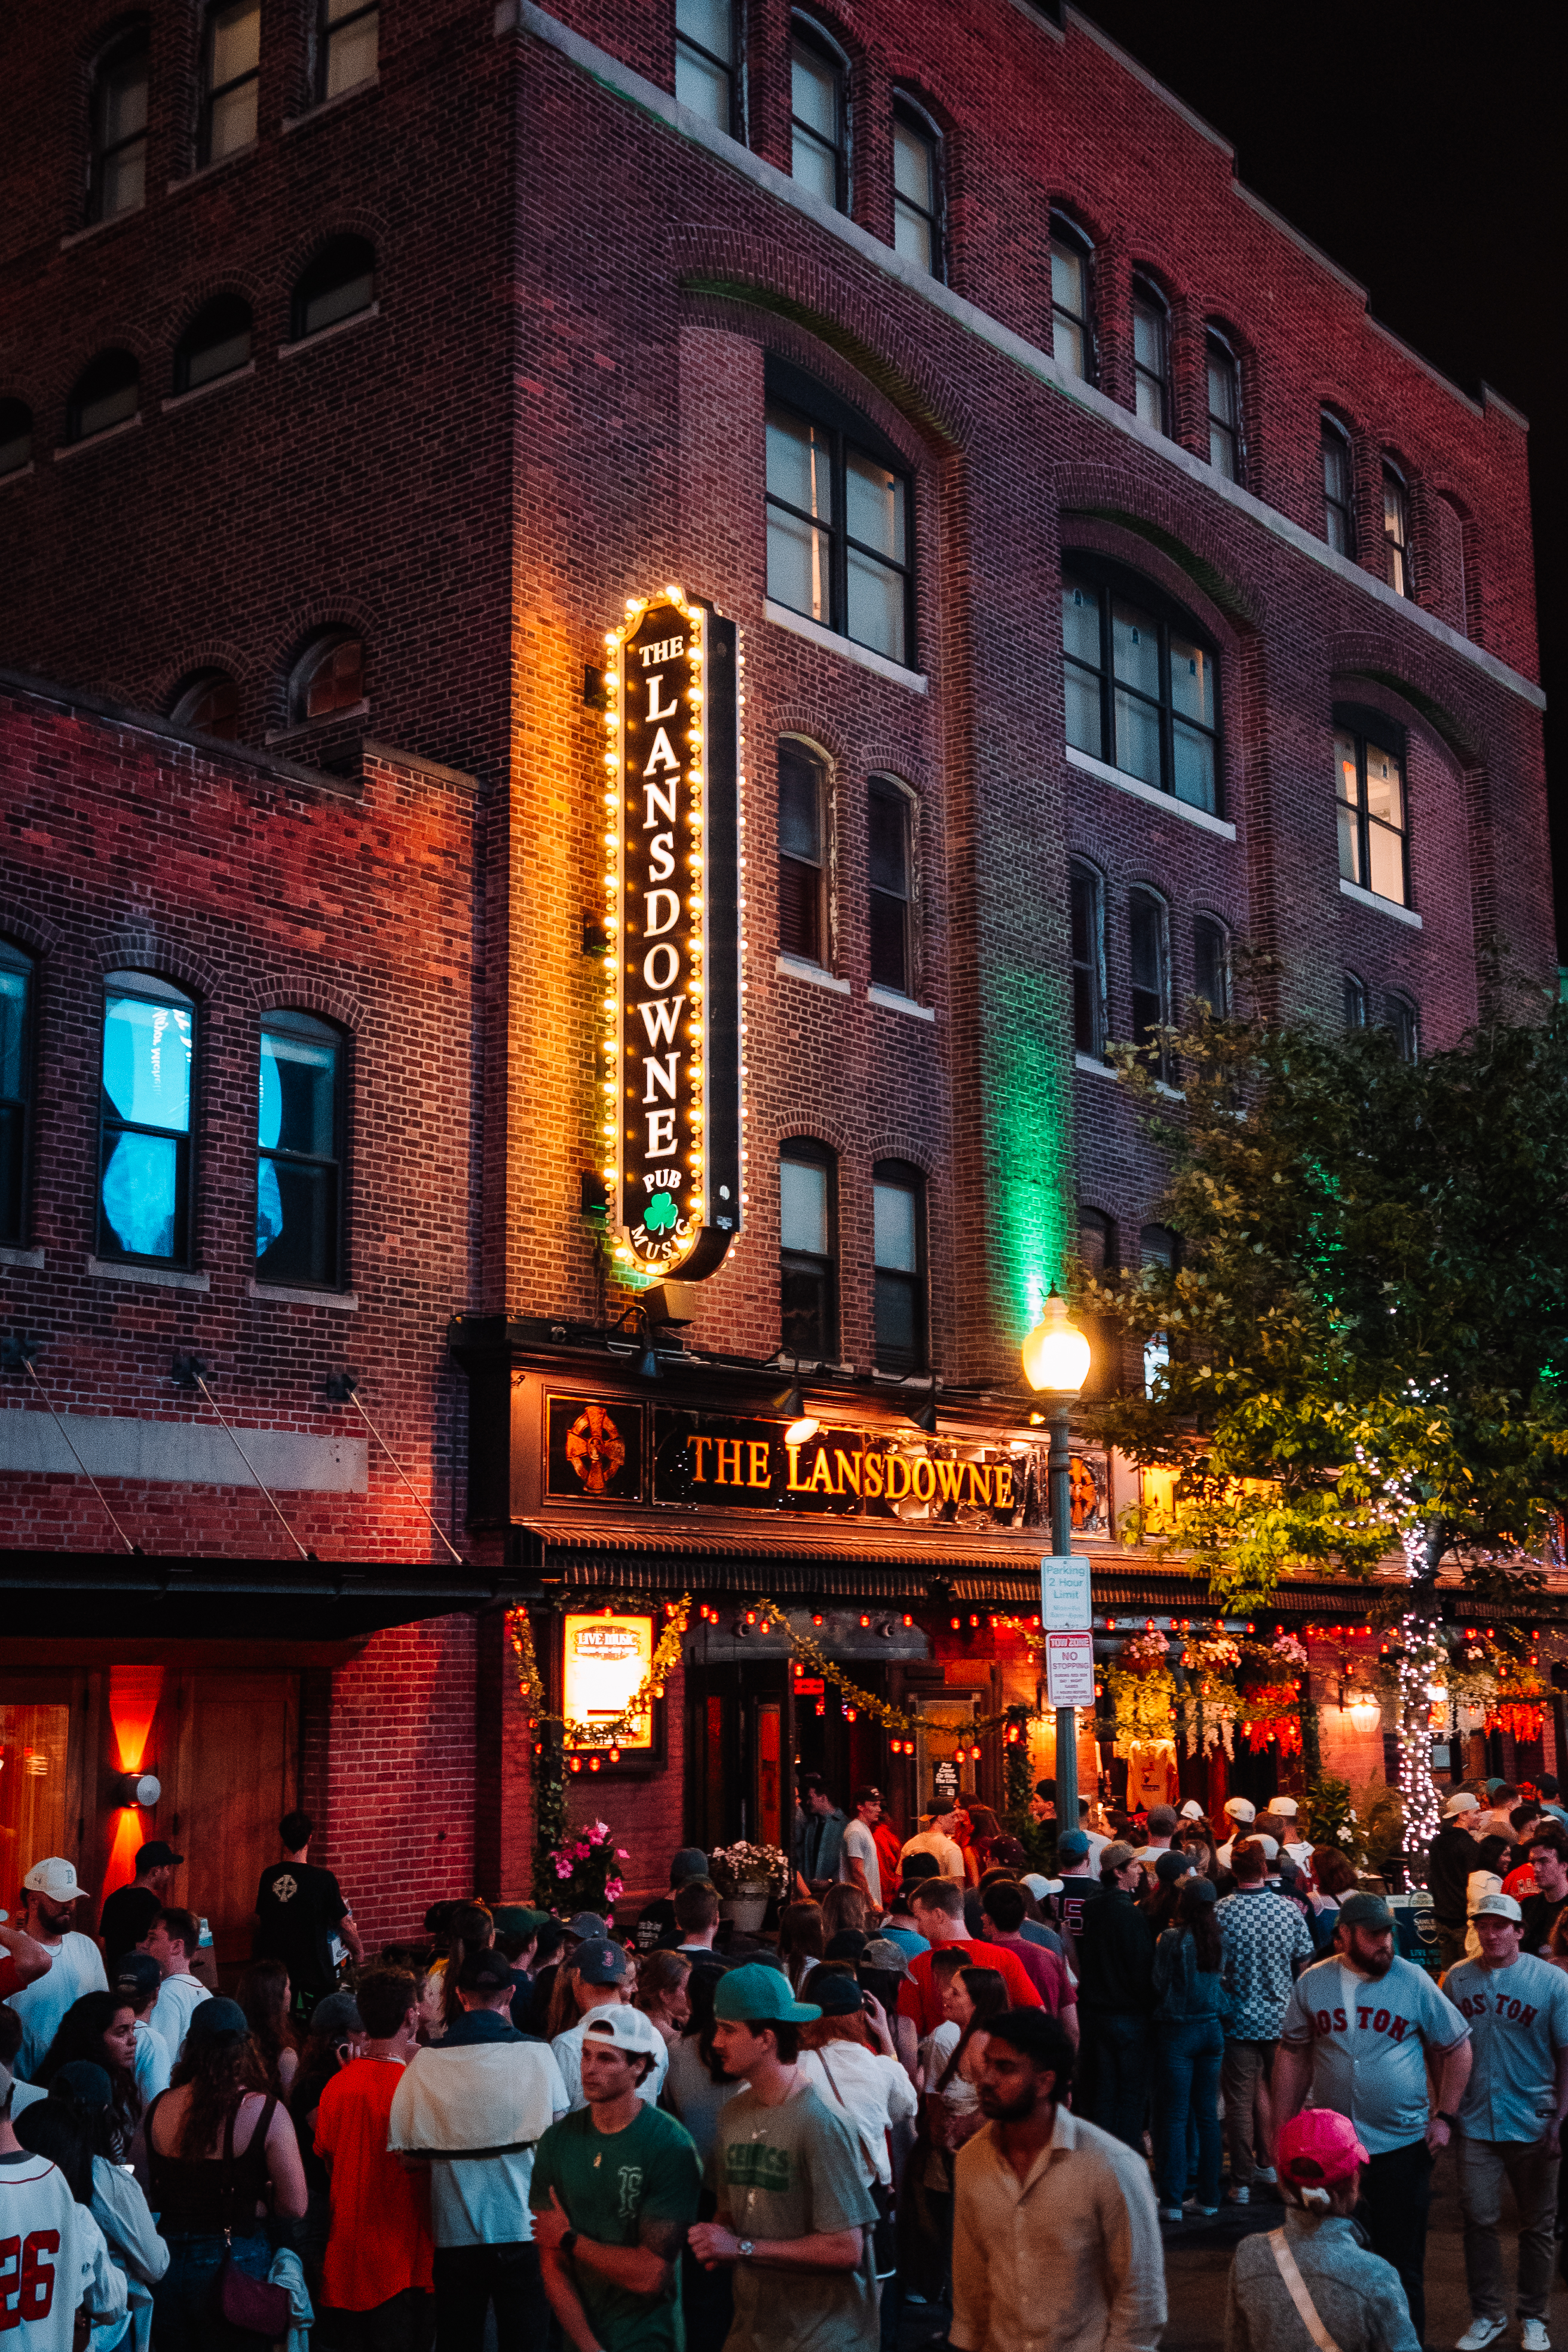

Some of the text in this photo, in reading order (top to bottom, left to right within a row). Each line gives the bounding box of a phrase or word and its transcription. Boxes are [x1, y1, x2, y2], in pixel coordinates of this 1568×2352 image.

[638, 635, 684, 667] THE
[636, 674, 687, 1159] LANSDOWNE
[642, 1168, 682, 1193] PUB
[687, 1435, 1015, 1509] THE LANSDOWNE
[1046, 1566, 1085, 1577] Parking
[1049, 1578, 1083, 1587] 2 Hour
[1054, 1590, 1079, 1599] Limit
[578, 1633, 638, 1646] LIVE MUSIC
[1062, 1652, 1078, 1661] NO
[1312, 2005, 1410, 2042] OSTON
[1456, 1992, 1538, 2028] OSTON
[0, 2229, 60, 2332] 26
